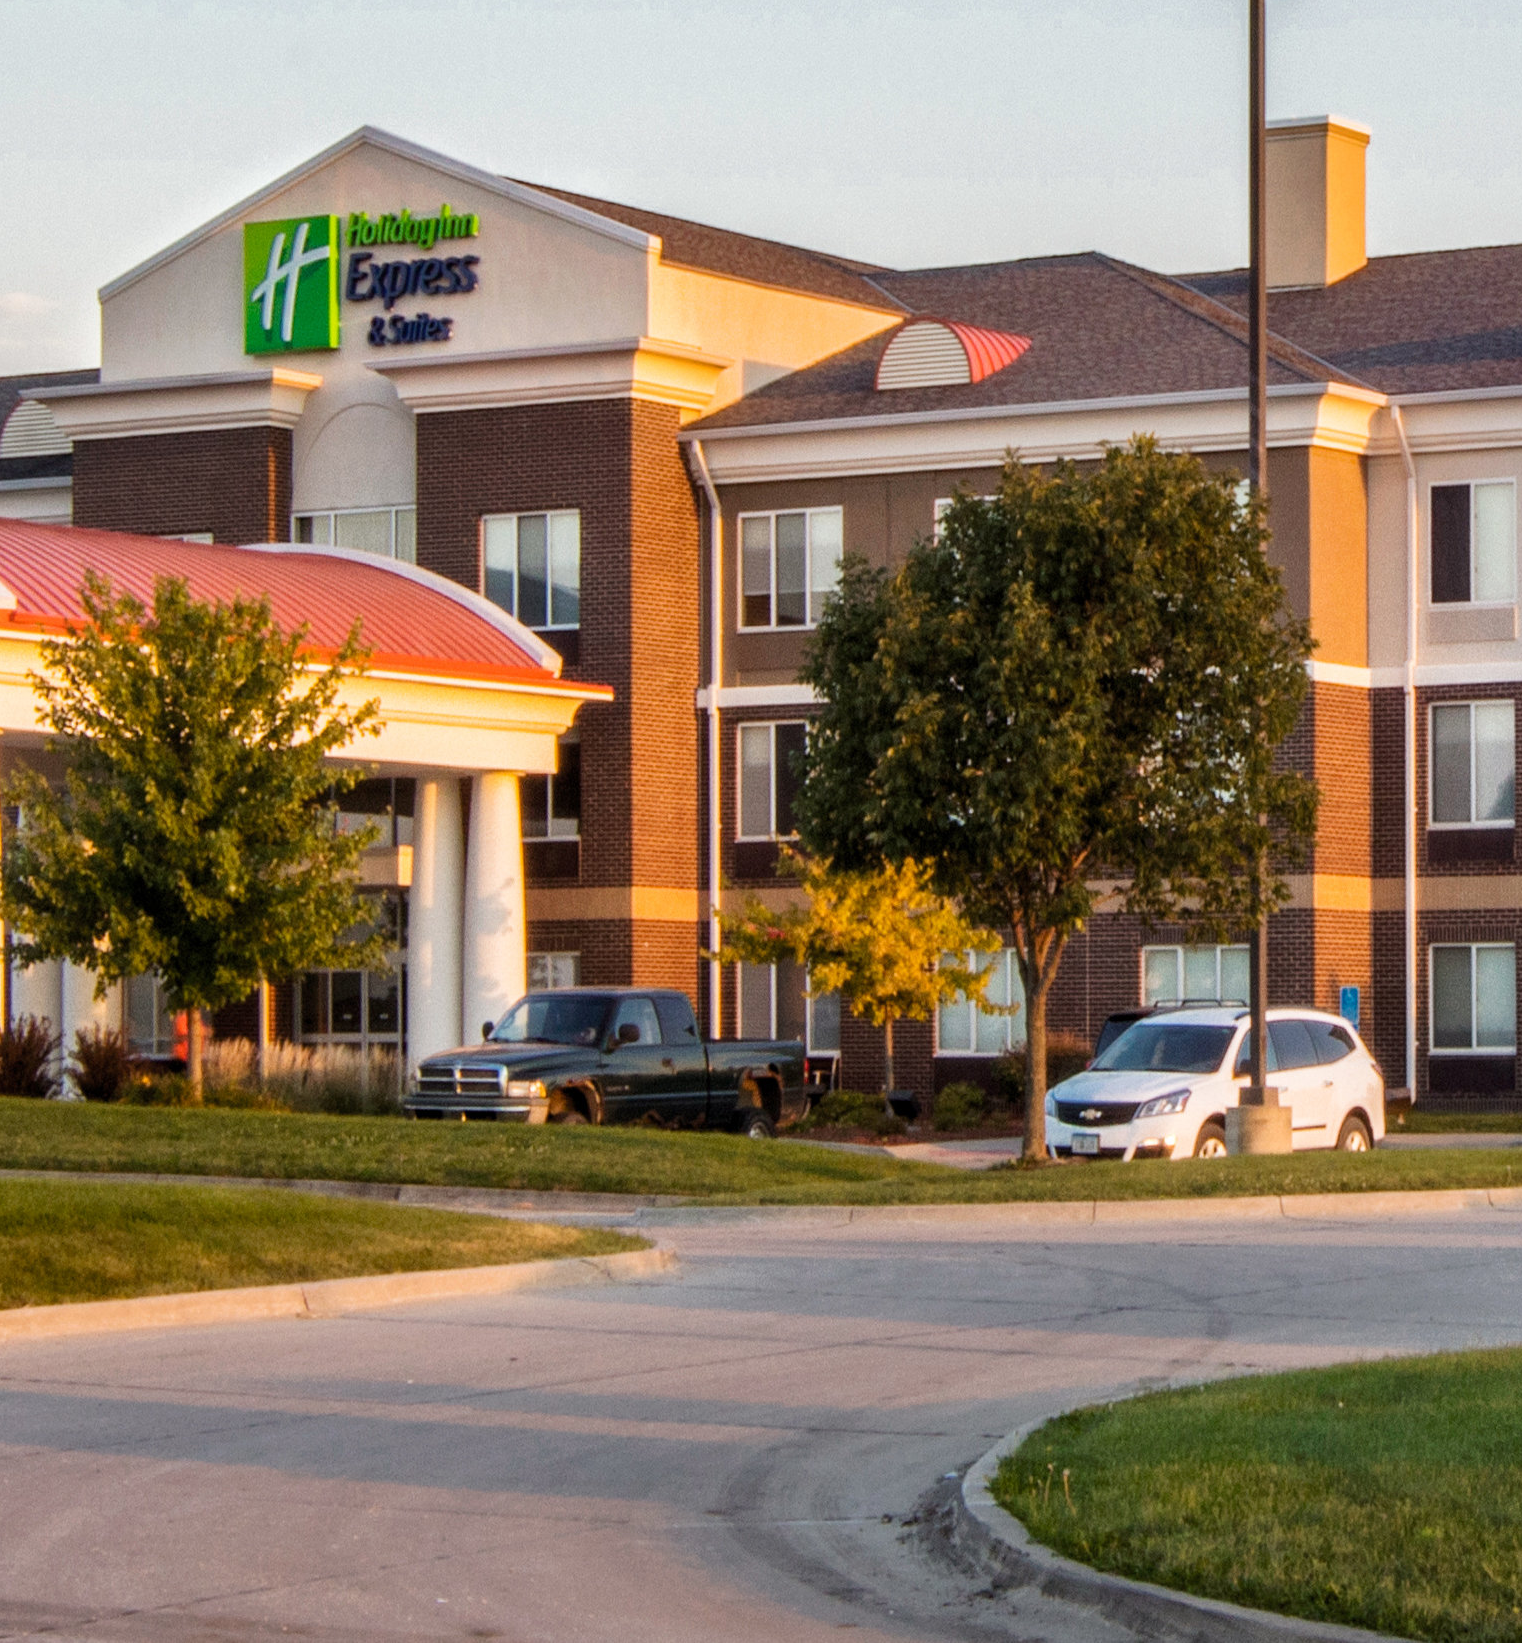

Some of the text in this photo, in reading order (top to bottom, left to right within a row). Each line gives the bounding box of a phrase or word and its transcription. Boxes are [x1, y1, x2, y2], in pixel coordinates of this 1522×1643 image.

[344, 203, 479, 250] Holiday Inn
[345, 252, 480, 309] Express
[367, 313, 454, 347] & Suites
